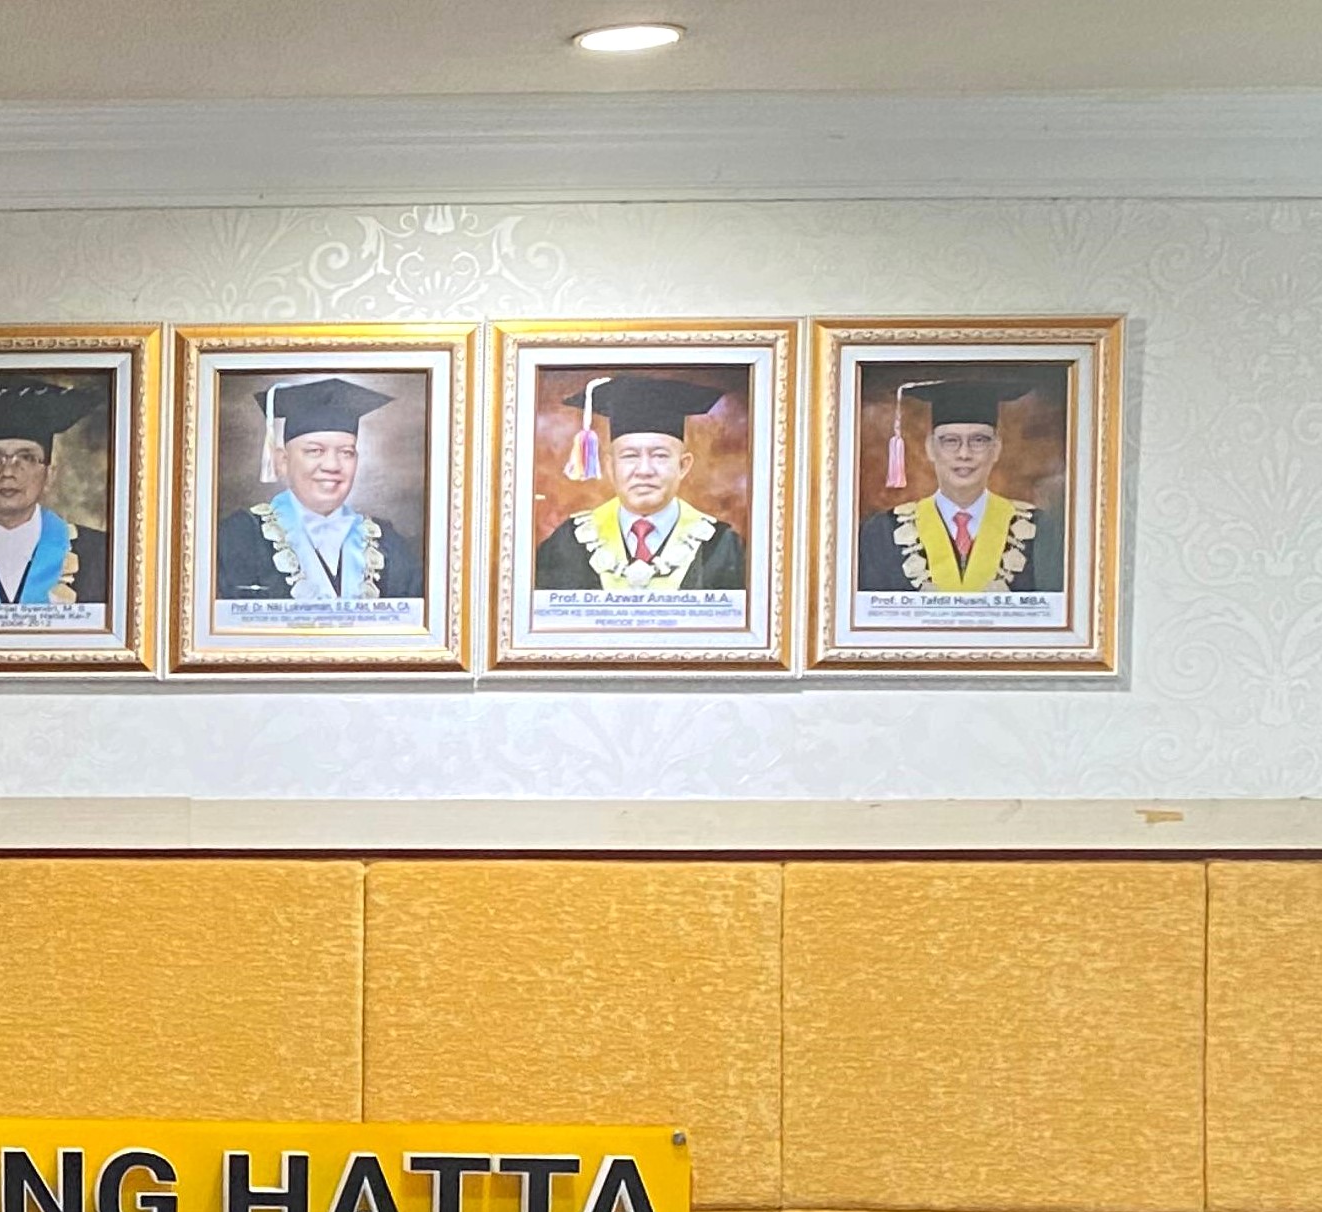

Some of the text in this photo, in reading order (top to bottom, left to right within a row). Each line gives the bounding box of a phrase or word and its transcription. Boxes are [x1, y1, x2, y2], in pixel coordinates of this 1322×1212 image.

[550, 593, 579, 603] Prof.
[584, 593, 601, 603] Dr.
[604, 592, 644, 603] Azwar
[647, 592, 700, 605] Ananda,
[871, 596, 896, 605] Prof.
